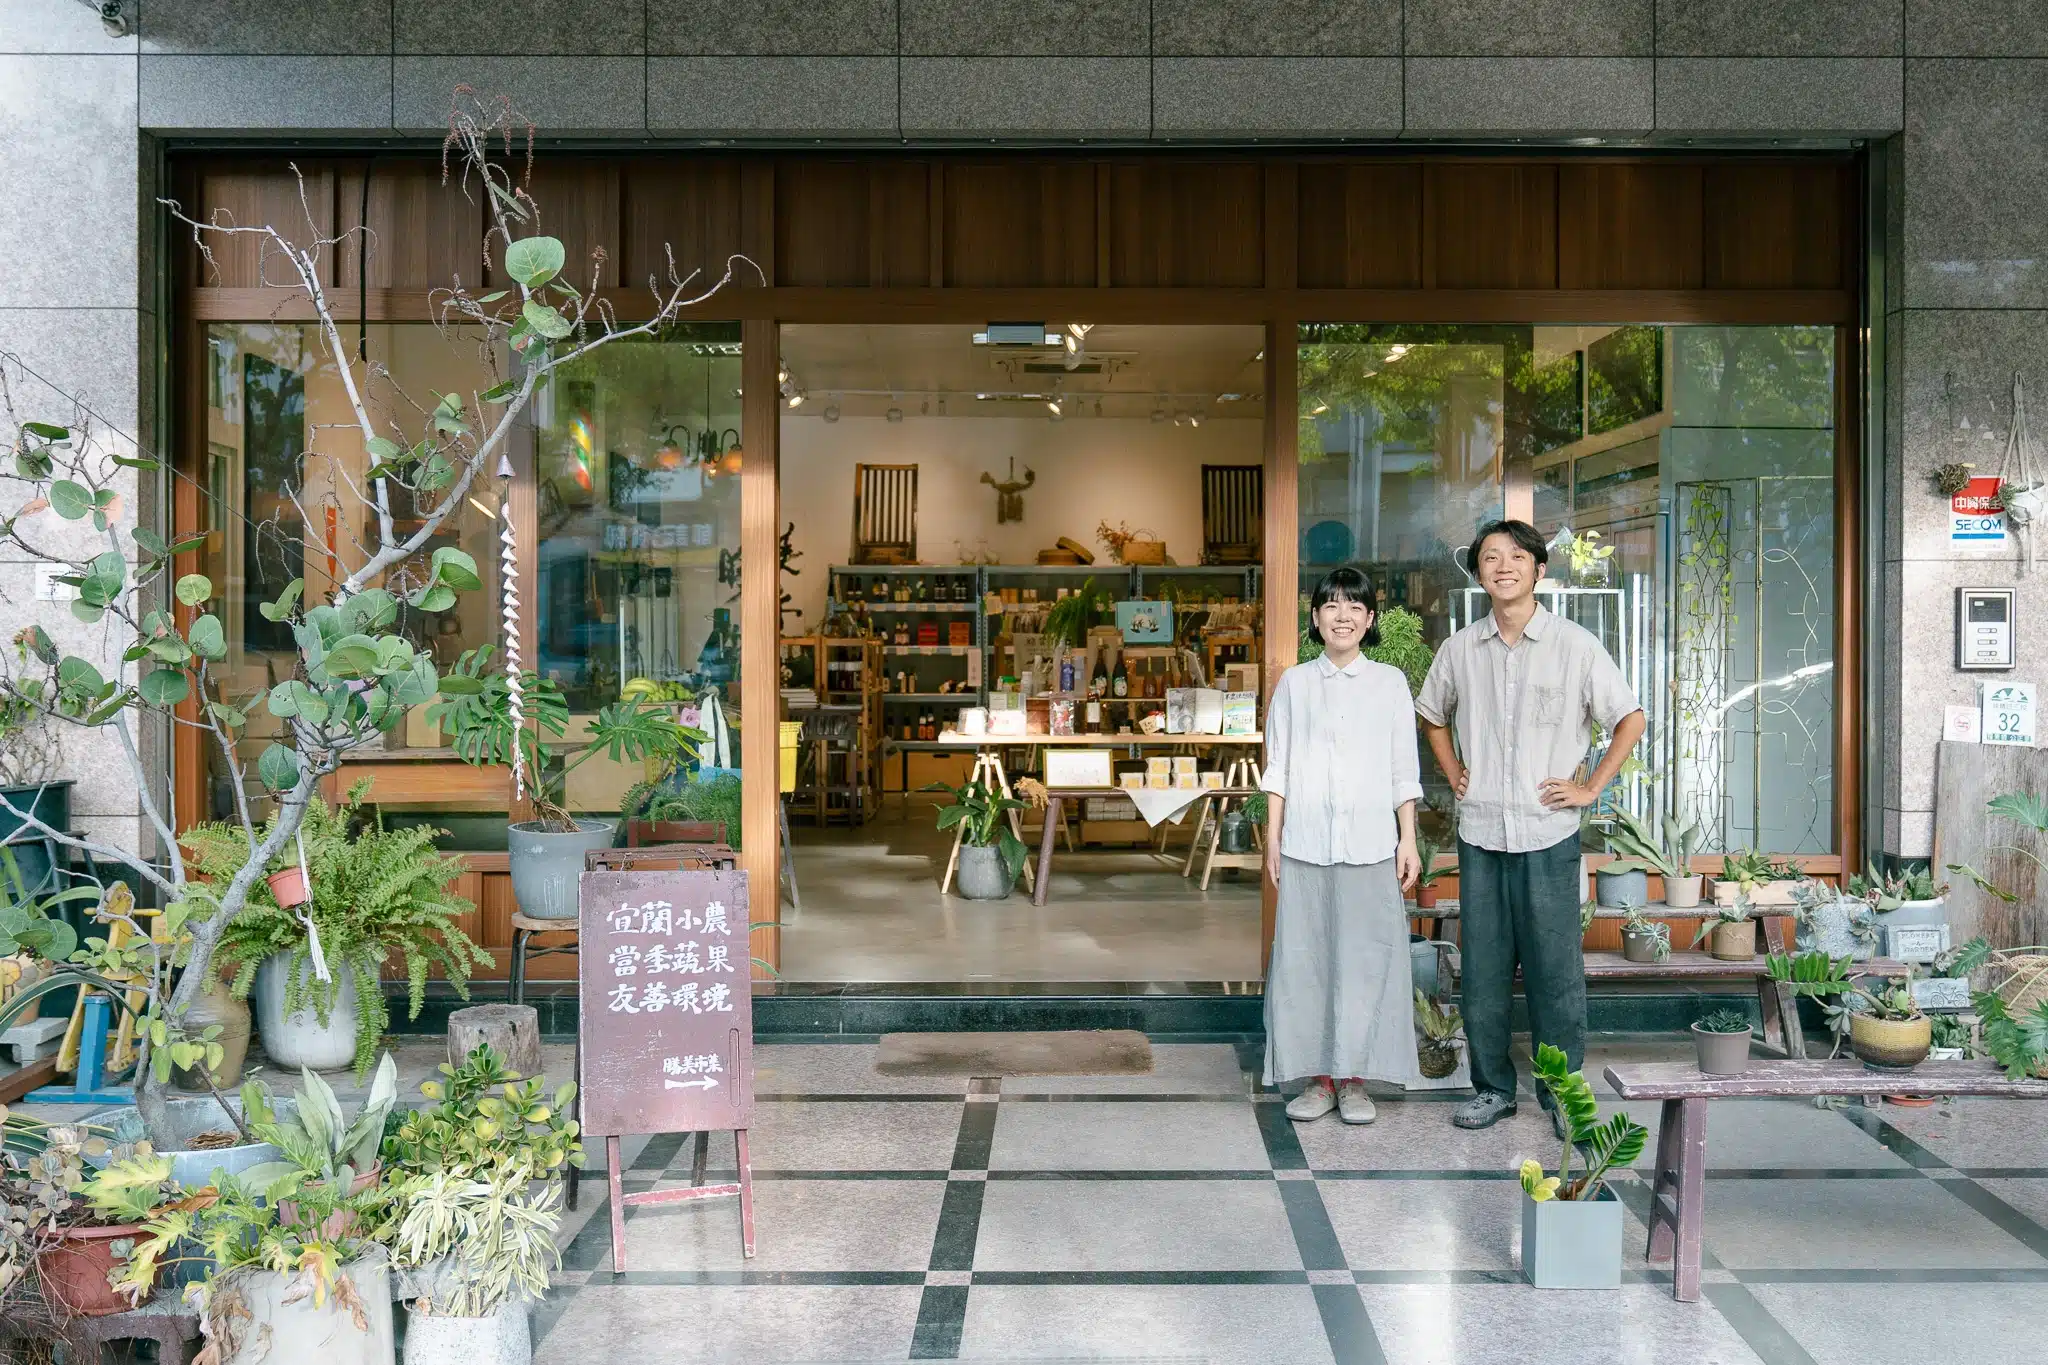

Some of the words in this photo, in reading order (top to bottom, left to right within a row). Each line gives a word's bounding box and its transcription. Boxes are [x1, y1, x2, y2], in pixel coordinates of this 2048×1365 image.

[1956, 519, 2002, 531] SECOM
[1998, 712, 2020, 732] 32
[606, 900, 732, 936] 宜蘭小農
[608, 941, 735, 977] 當季蔬果
[607, 981, 734, 1014] 友善環境
